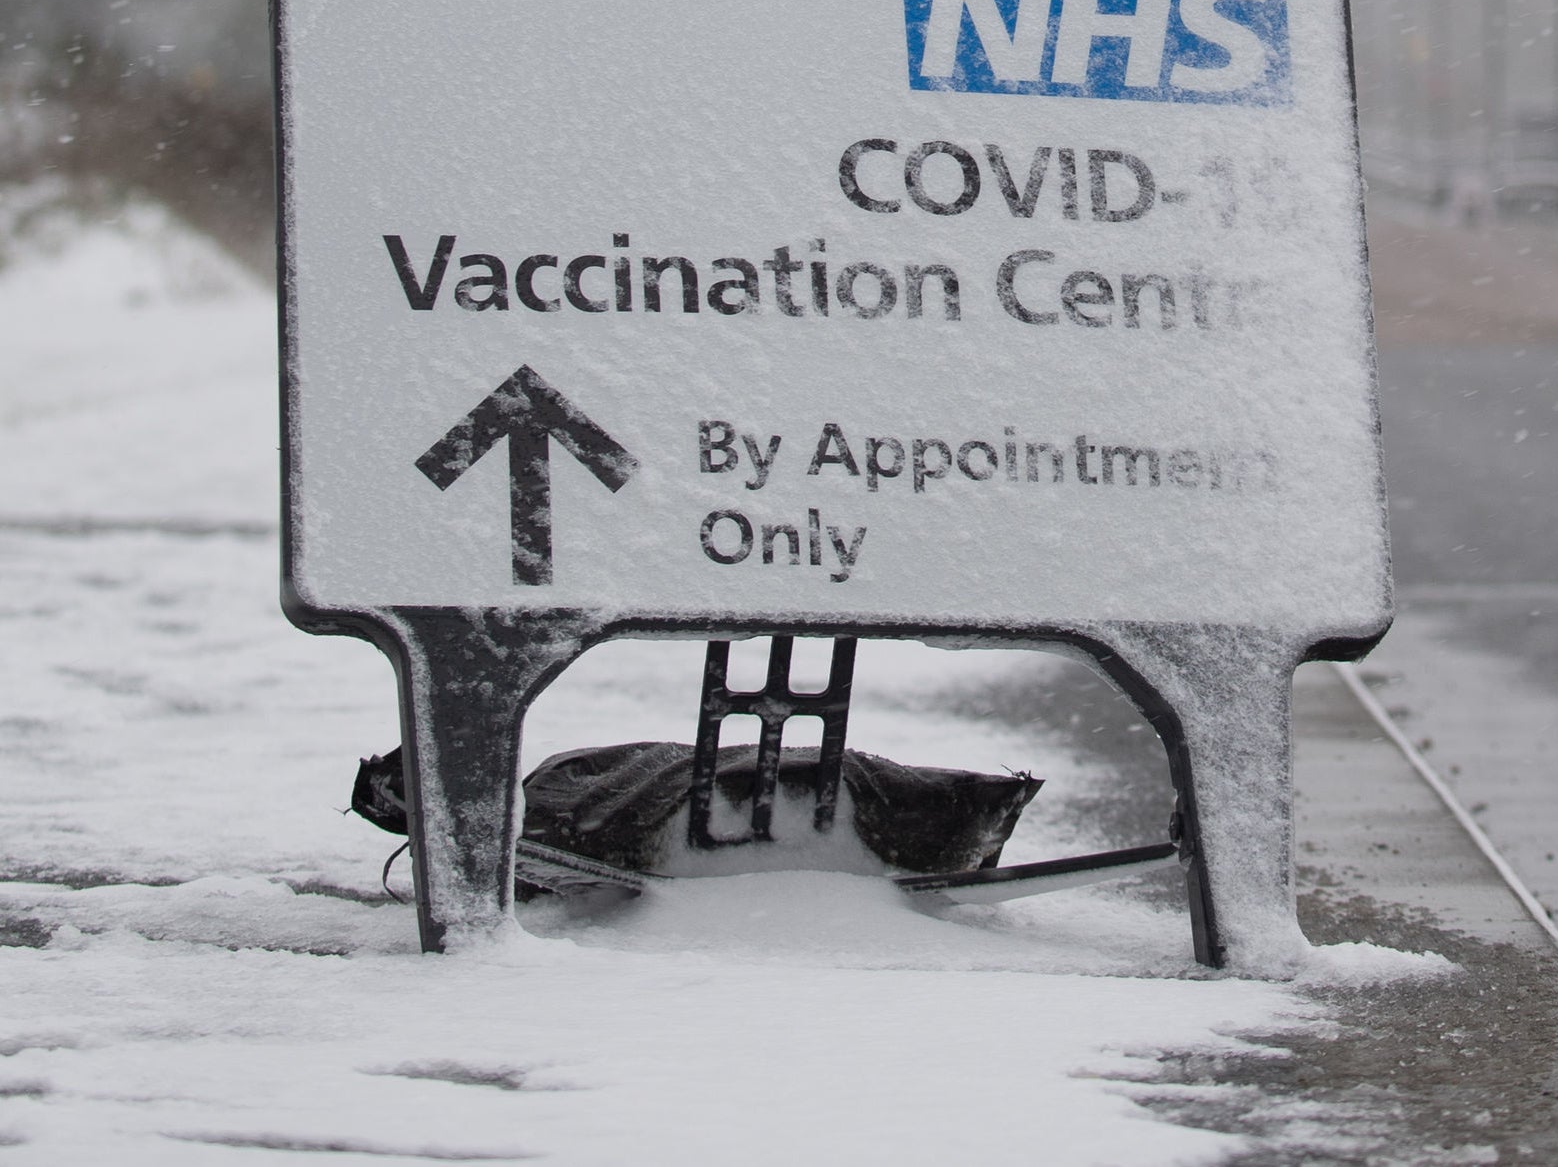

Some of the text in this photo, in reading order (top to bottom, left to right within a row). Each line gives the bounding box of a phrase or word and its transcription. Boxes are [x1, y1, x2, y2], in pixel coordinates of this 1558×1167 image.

[838, 137, 1304, 232] COVID-1
[382, 232, 1274, 331] Vaccination Centr
[699, 420, 782, 491] By
[700, 507, 867, 583] Only
